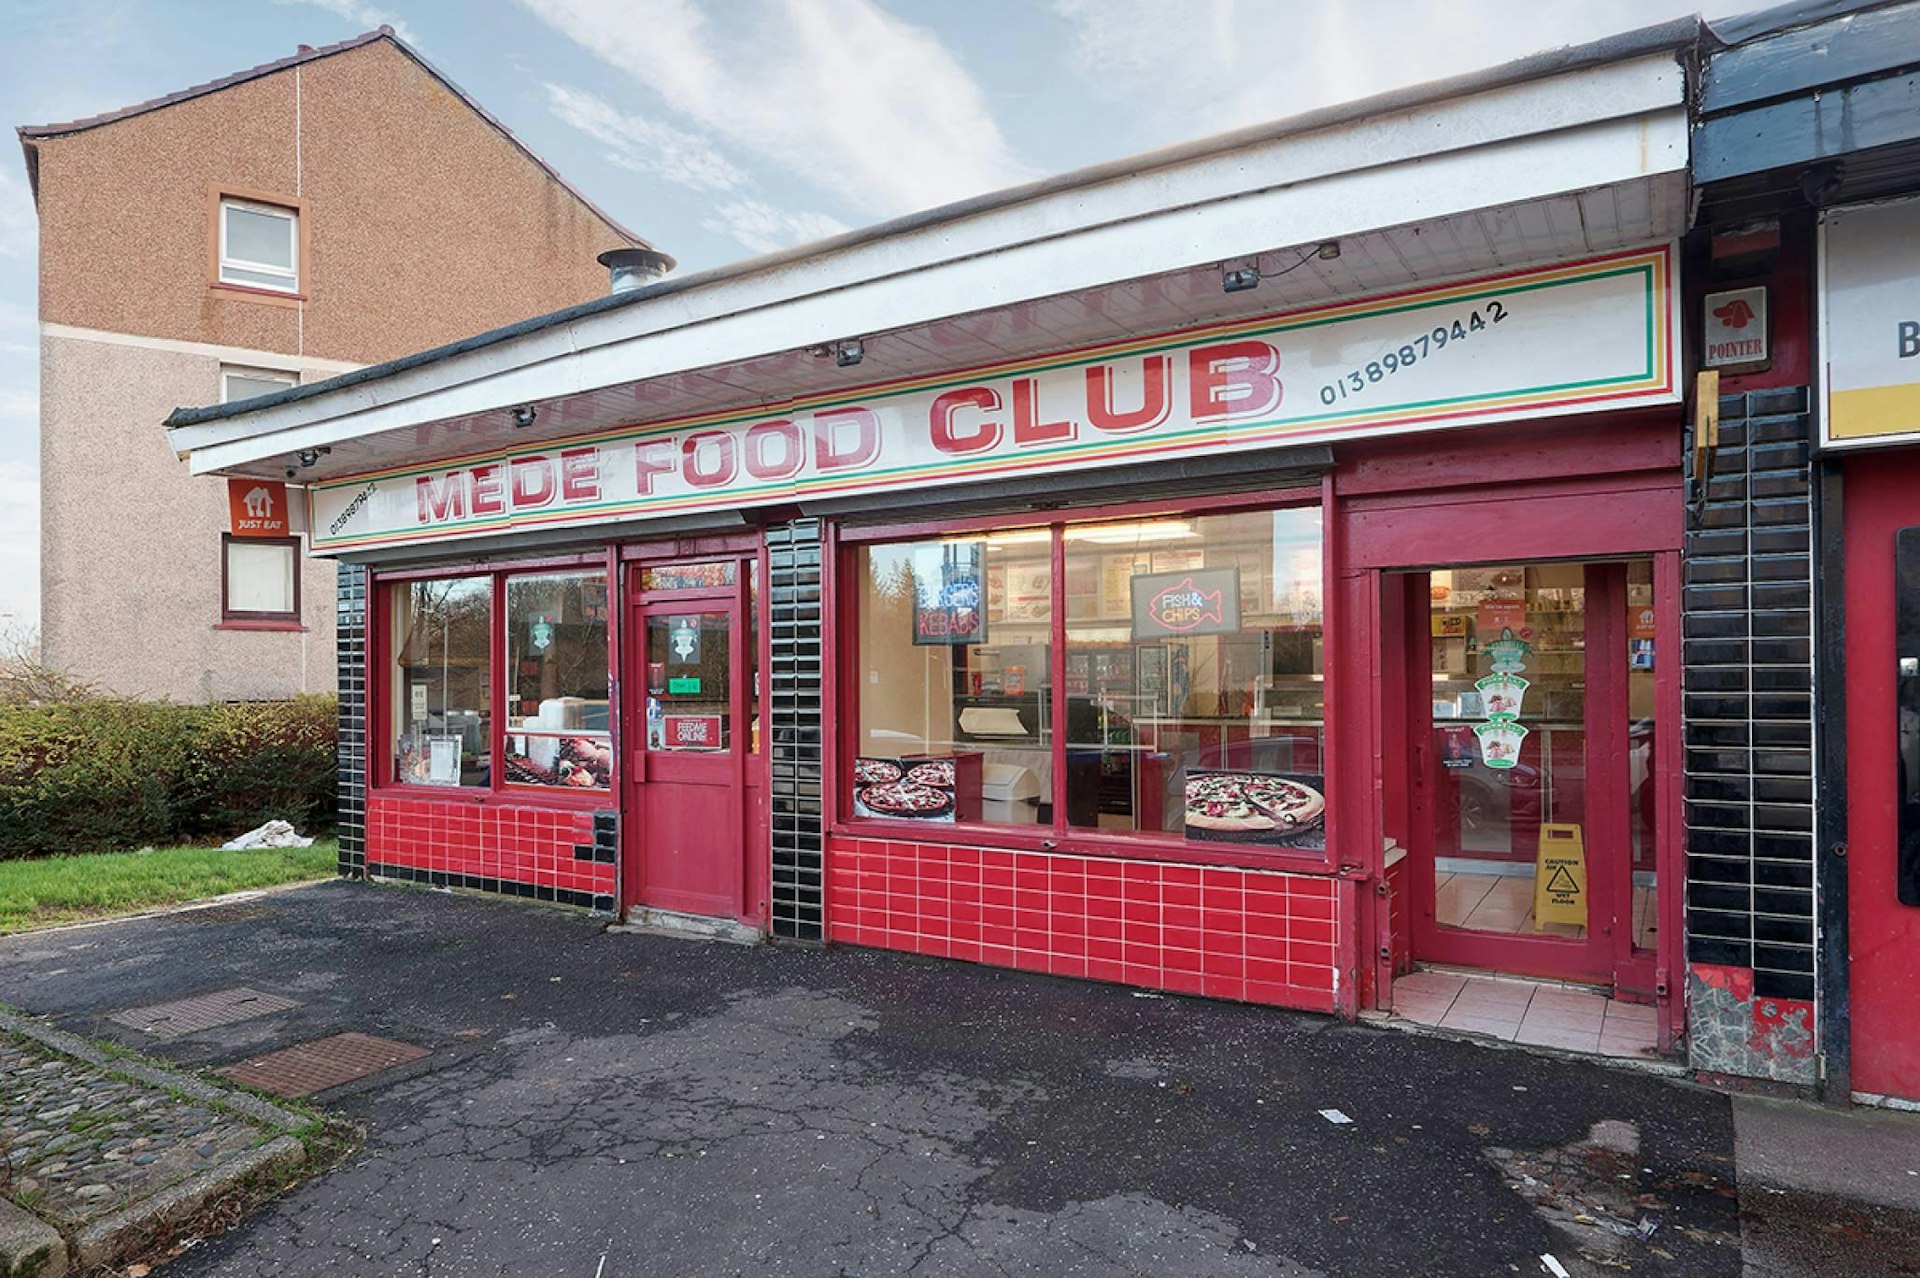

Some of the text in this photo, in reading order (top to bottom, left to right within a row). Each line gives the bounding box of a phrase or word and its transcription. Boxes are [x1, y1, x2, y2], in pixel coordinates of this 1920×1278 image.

[1320, 301, 1509, 405] 01389879442
[1708, 338, 1763, 361] POINTER
[416, 340, 1283, 522] MEDE FOOD CLUB
[238, 519, 283, 530] JUST EAT
[918, 611, 980, 637] KEBABS
